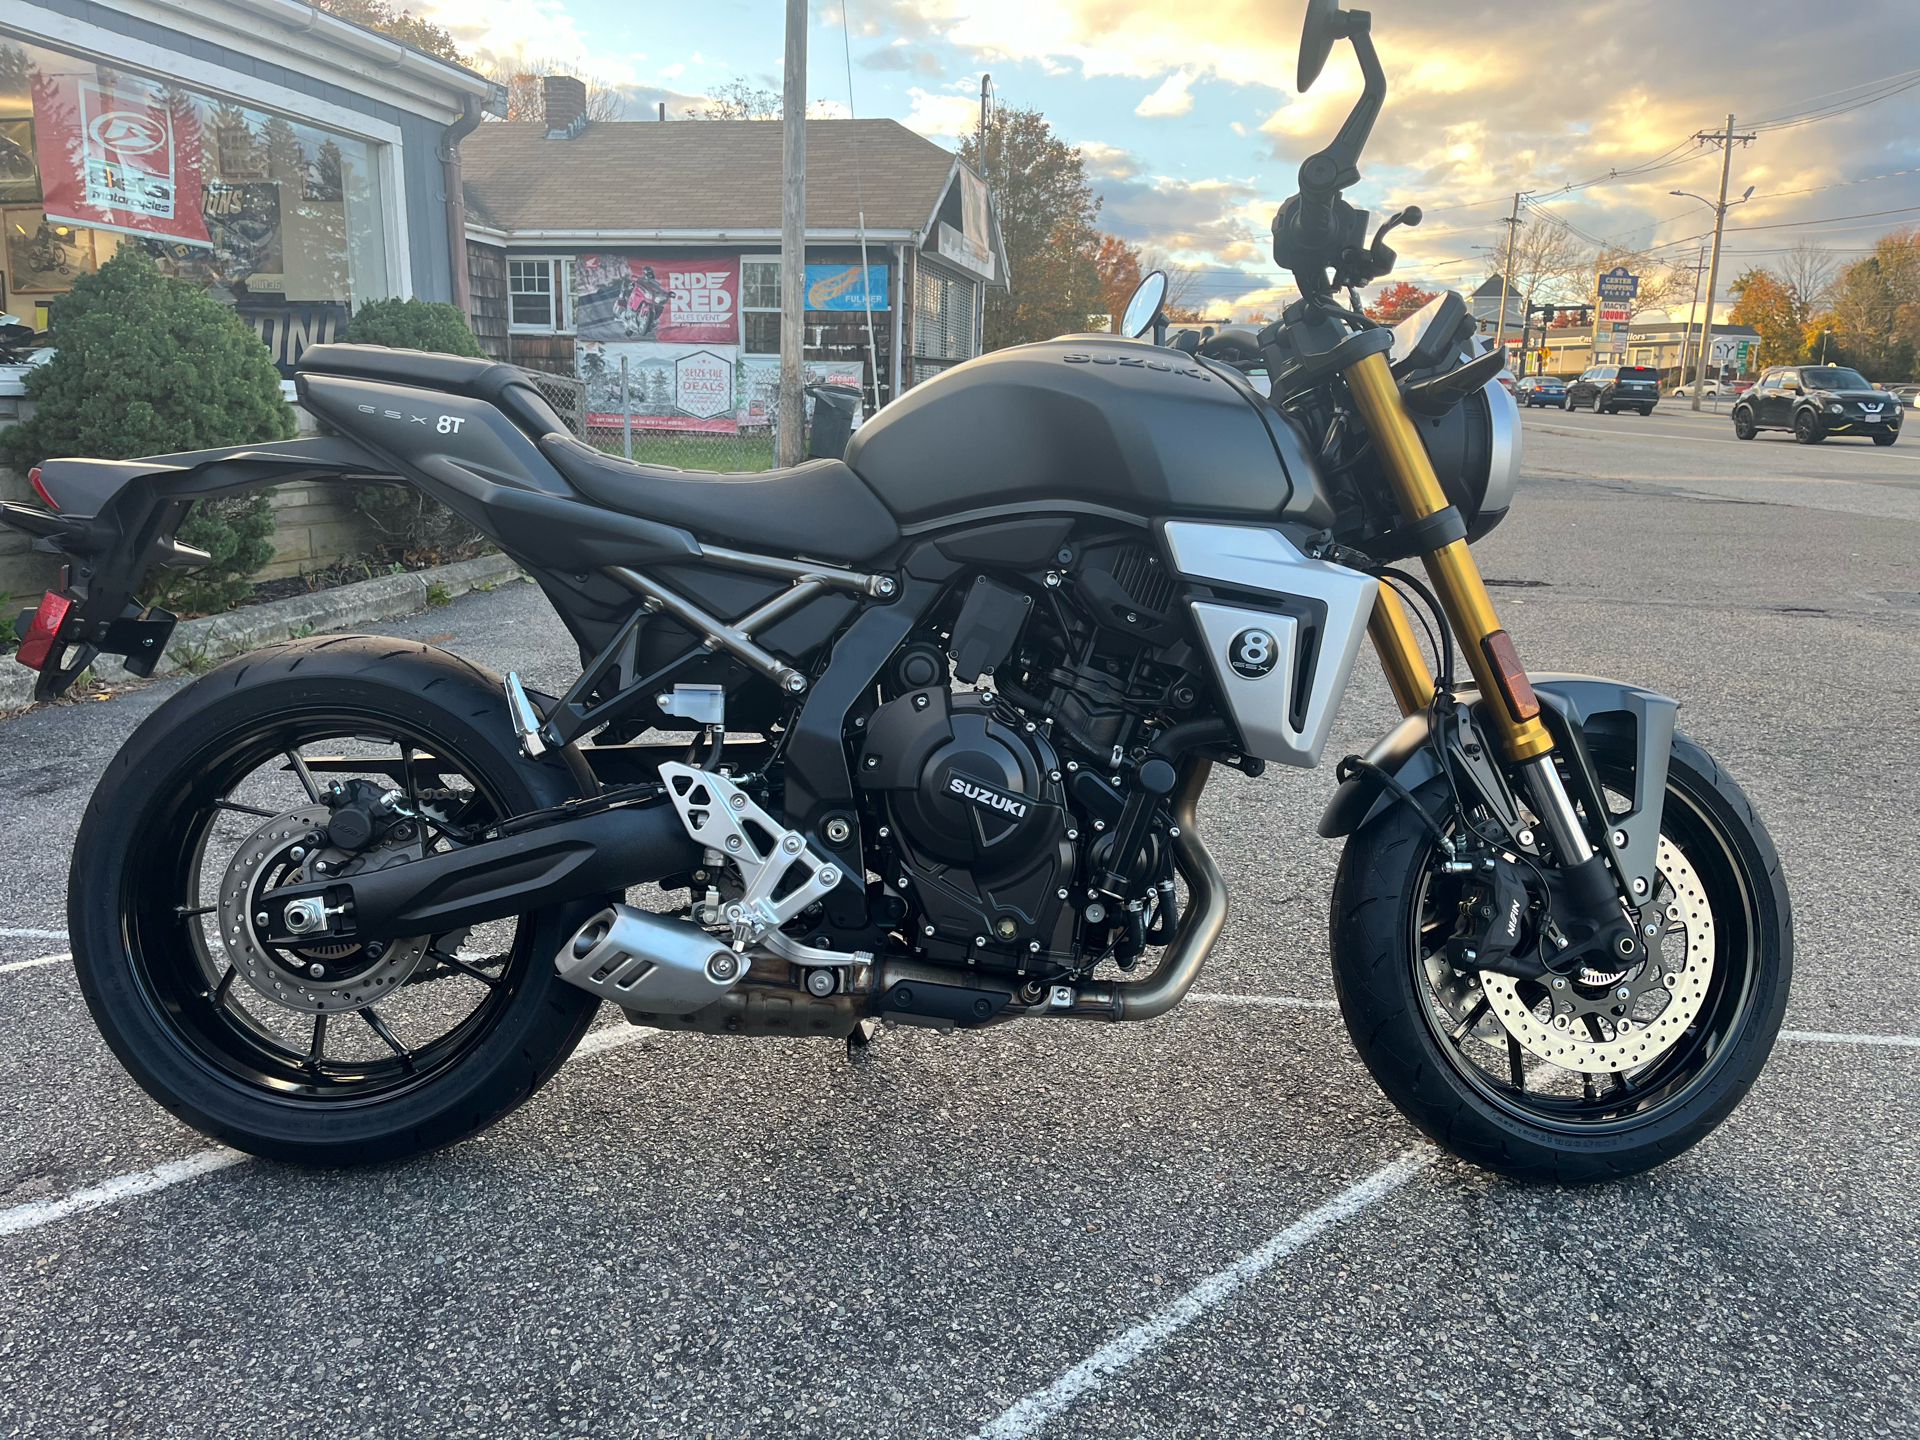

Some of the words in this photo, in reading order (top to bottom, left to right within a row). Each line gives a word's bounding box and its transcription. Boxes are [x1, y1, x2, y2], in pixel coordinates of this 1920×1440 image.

[92, 191, 170, 213] motorcycles
[669, 272, 731, 289] RIDE
[1605, 277, 1632, 285] CENTER
[671, 289, 732, 312] RED
[685, 368, 706, 377] SEIZE
[708, 369, 723, 378] THE
[1063, 353, 1212, 382] SUZUKI
[683, 381, 725, 392] DEALS
[827, 374, 856, 383] dream
[436, 415, 466, 434] 8T
[1240, 631, 1269, 664] 8
[1232, 661, 1270, 672] GSX
[949, 778, 1027, 818] SUZUKI
